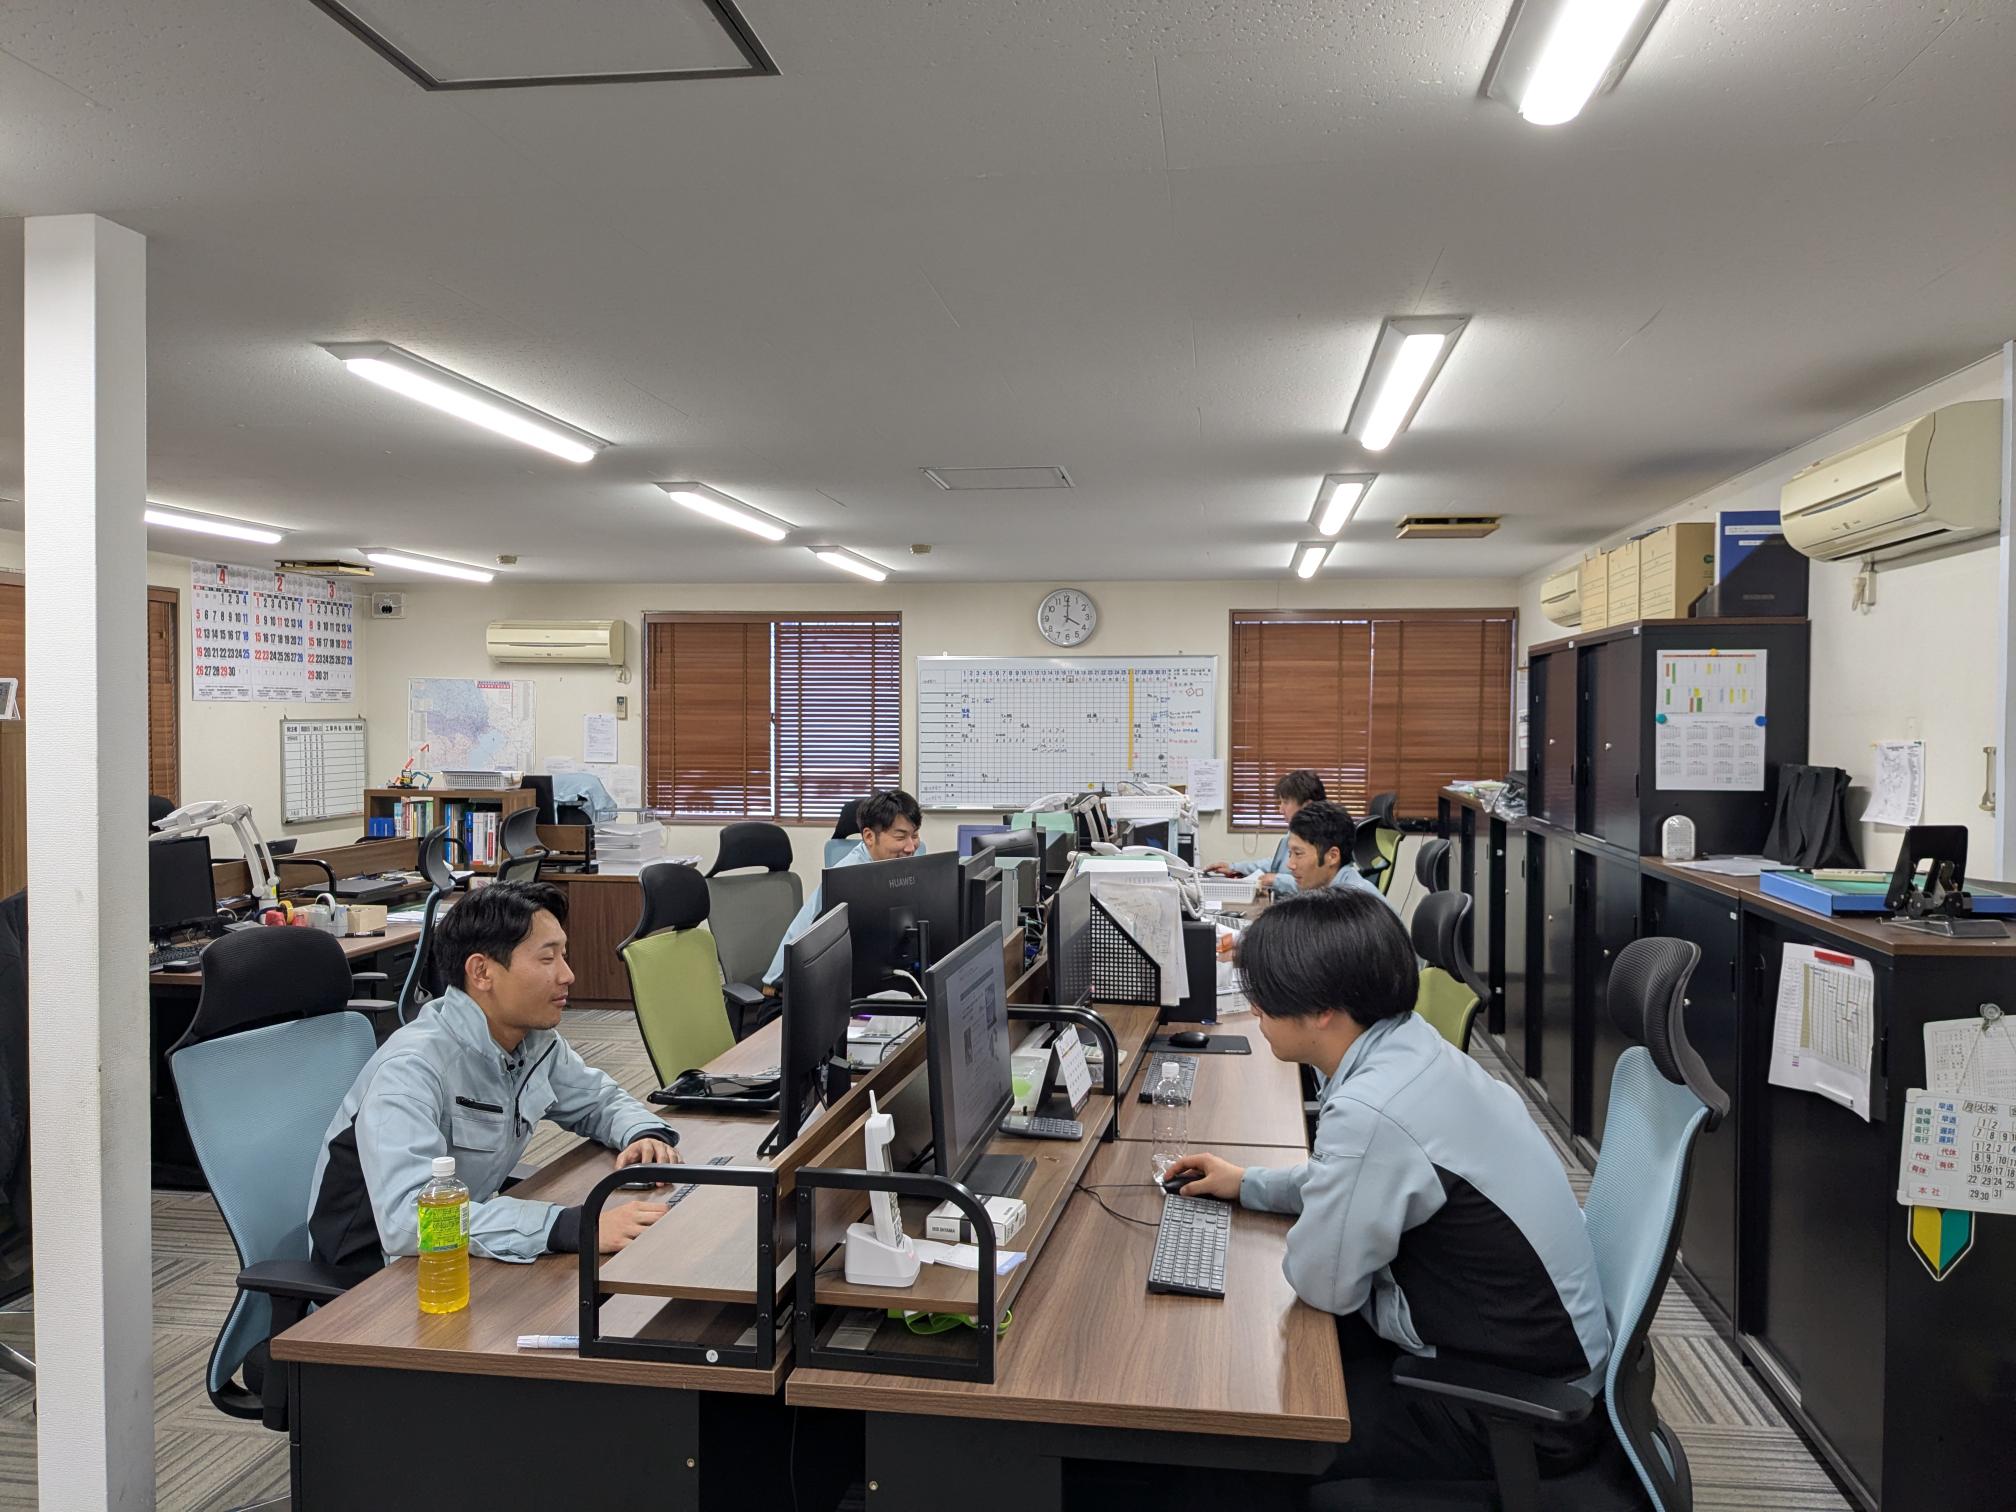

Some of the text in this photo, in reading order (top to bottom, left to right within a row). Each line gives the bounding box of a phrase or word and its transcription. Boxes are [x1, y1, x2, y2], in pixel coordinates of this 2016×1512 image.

[219, 568, 225, 585] 4
[277, 576, 283, 592] 2
[330, 584, 334, 599] 3
[1055, 598, 1061, 606] 11
[1048, 605, 1055, 613] 10
[243, 613, 248, 623] 11
[270, 616, 275, 626] 10
[277, 617, 282, 626] 11
[284, 618, 289, 627] 12
[291, 618, 296, 627] 13
[298, 619, 302, 628] 14
[196, 628, 202, 638] 12
[204, 629, 210, 638] 13
[212, 629, 218, 639] 14
[220, 630, 226, 640] 15
[228, 630, 233, 640] 16
[235, 631, 241, 640] 17
[255, 633, 261, 642] 15
[263, 633, 268, 642] 16
[270, 634, 276, 643] 17
[284, 635, 289, 644] 19
[291, 636, 296, 645] 20
[298, 636, 303, 645] 21
[204, 647, 211, 657] 20
[212, 648, 219, 658] 21
[220, 648, 227, 658] 22
[228, 648, 234, 658] 23
[235, 649, 242, 658] 24
[243, 649, 250, 659] 25
[255, 650, 303, 662] 22 23 24 25 26 27 28
[196, 666, 235, 676] 26 27 28 29 30
[889, 876, 915, 888] HUAWEI
[1991, 1121, 1998, 1129] 2
[1986, 1143, 1991, 1151] 2
[1975, 1153, 1979, 1161] 8
[1998, 1156, 2007, 1164] 10
[1973, 1164, 2015, 1178] 15 16 17 18
[1968, 1175, 2015, 1189] 22 23 24 25
[1970, 1189, 2002, 1200] 29 30 31
